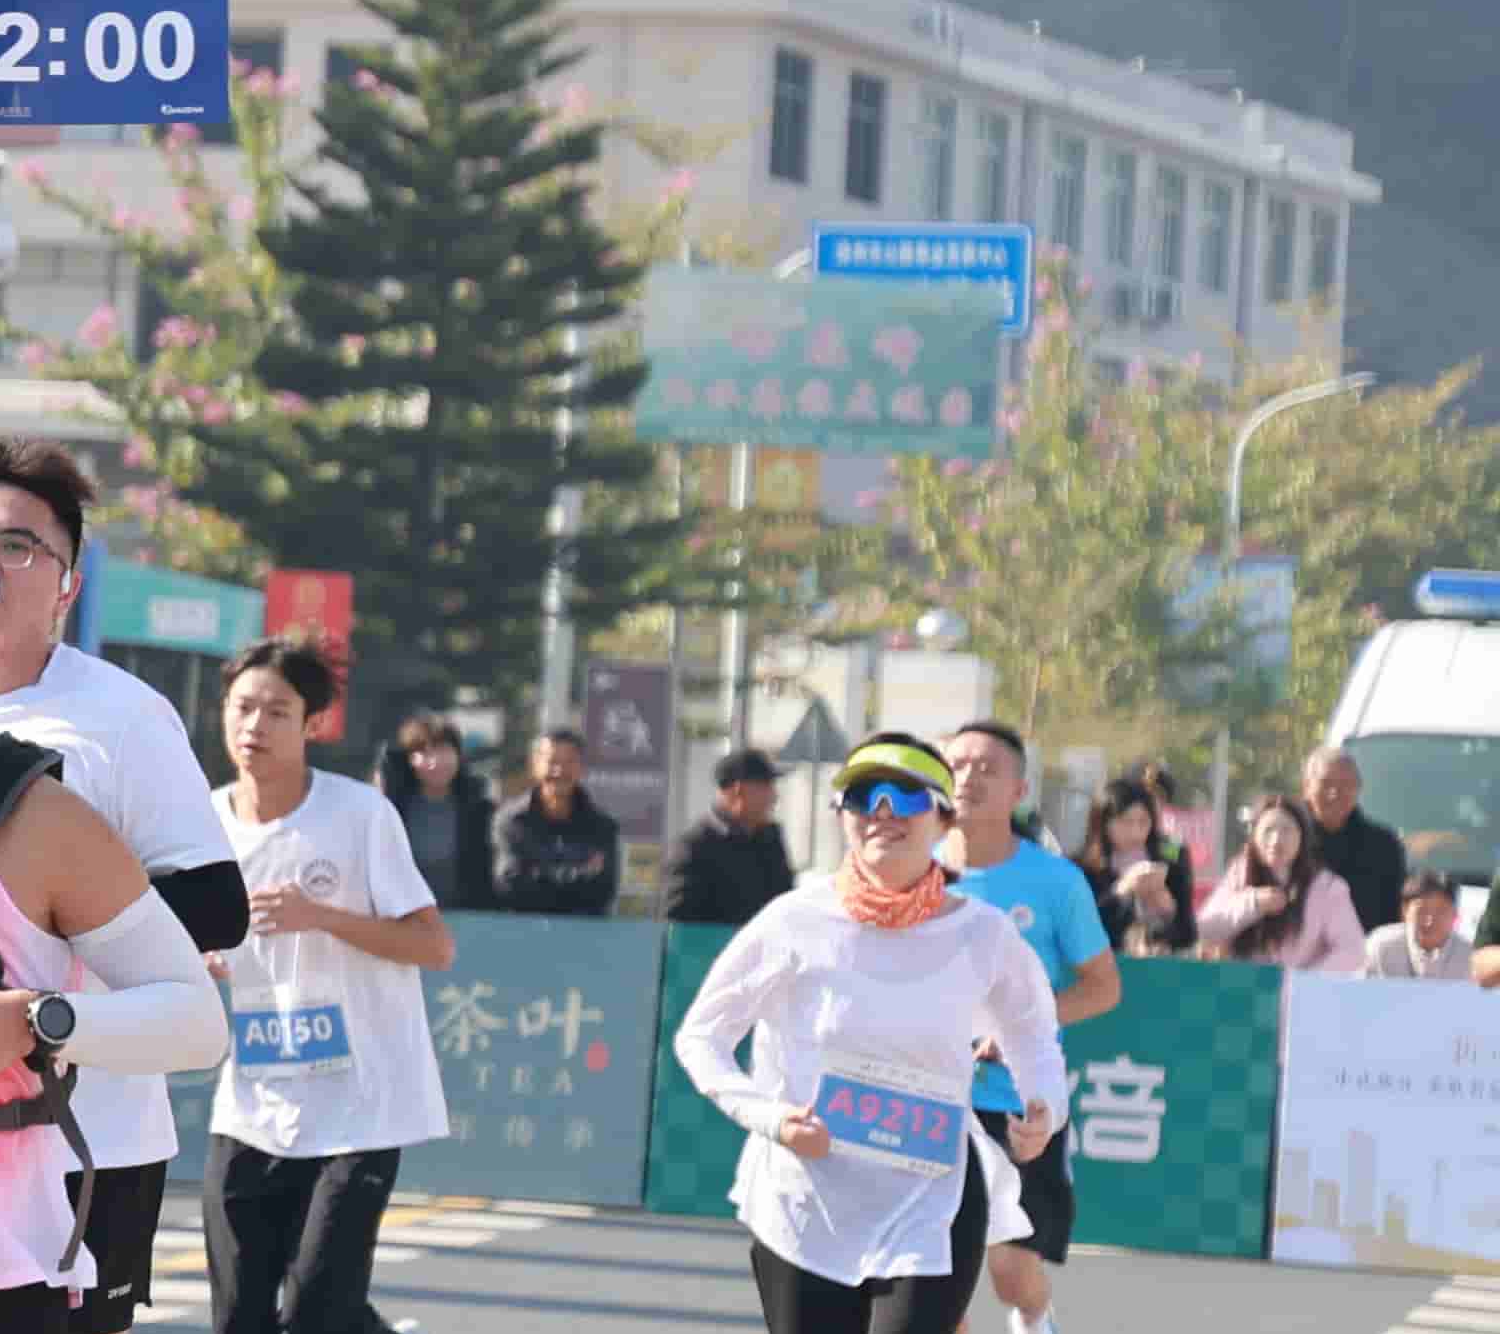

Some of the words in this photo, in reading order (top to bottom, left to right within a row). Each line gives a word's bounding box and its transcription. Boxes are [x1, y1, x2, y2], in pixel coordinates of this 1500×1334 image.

[431, 980, 604, 1059] 茶叶
[827, 1087, 950, 1143] A9212
[1068, 1054, 1167, 1163] 音
